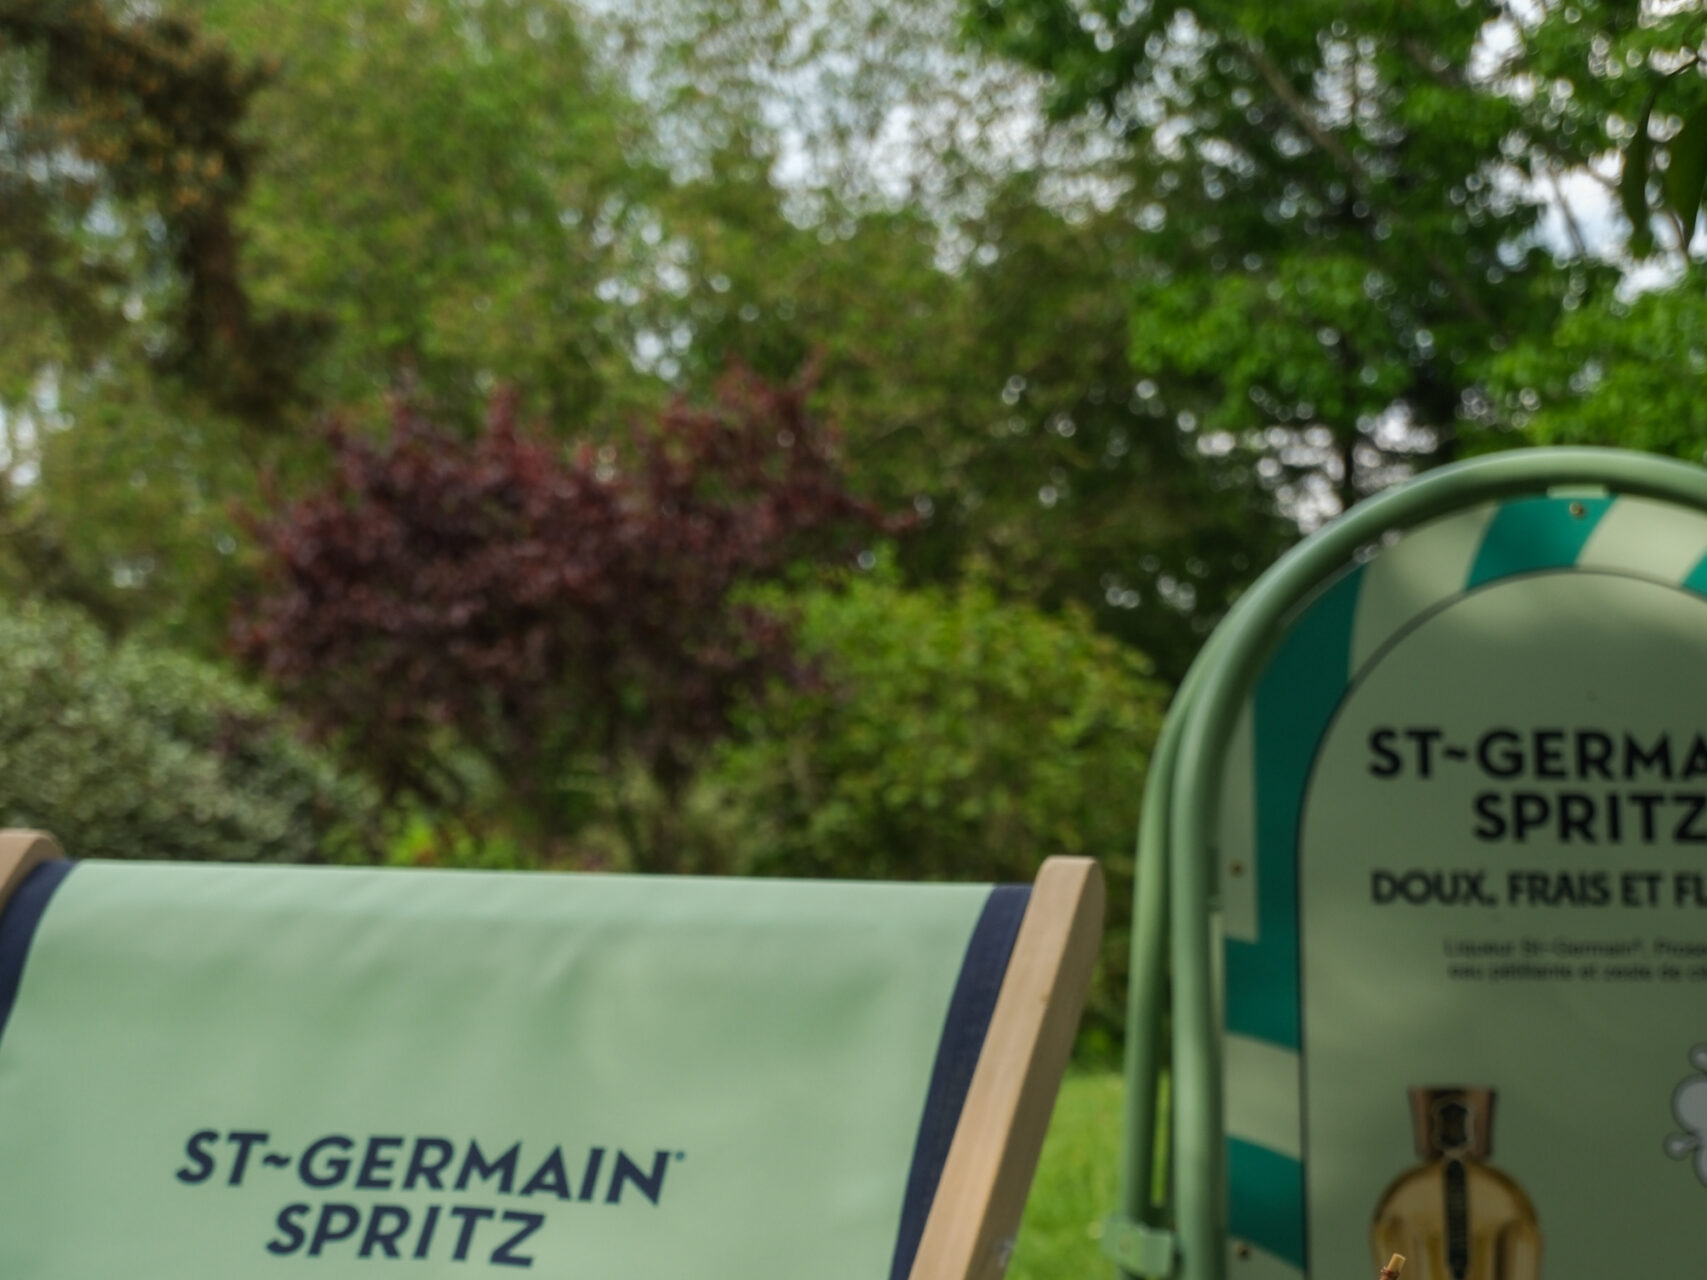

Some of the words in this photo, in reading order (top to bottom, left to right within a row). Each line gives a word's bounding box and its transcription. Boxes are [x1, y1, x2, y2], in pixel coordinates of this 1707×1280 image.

[1473, 791, 1707, 845] SPRITZ
[1507, 869, 1612, 908] FRAIS
[1620, 870, 1664, 908] ET
[266, 1203, 546, 1268] SPRITZ
